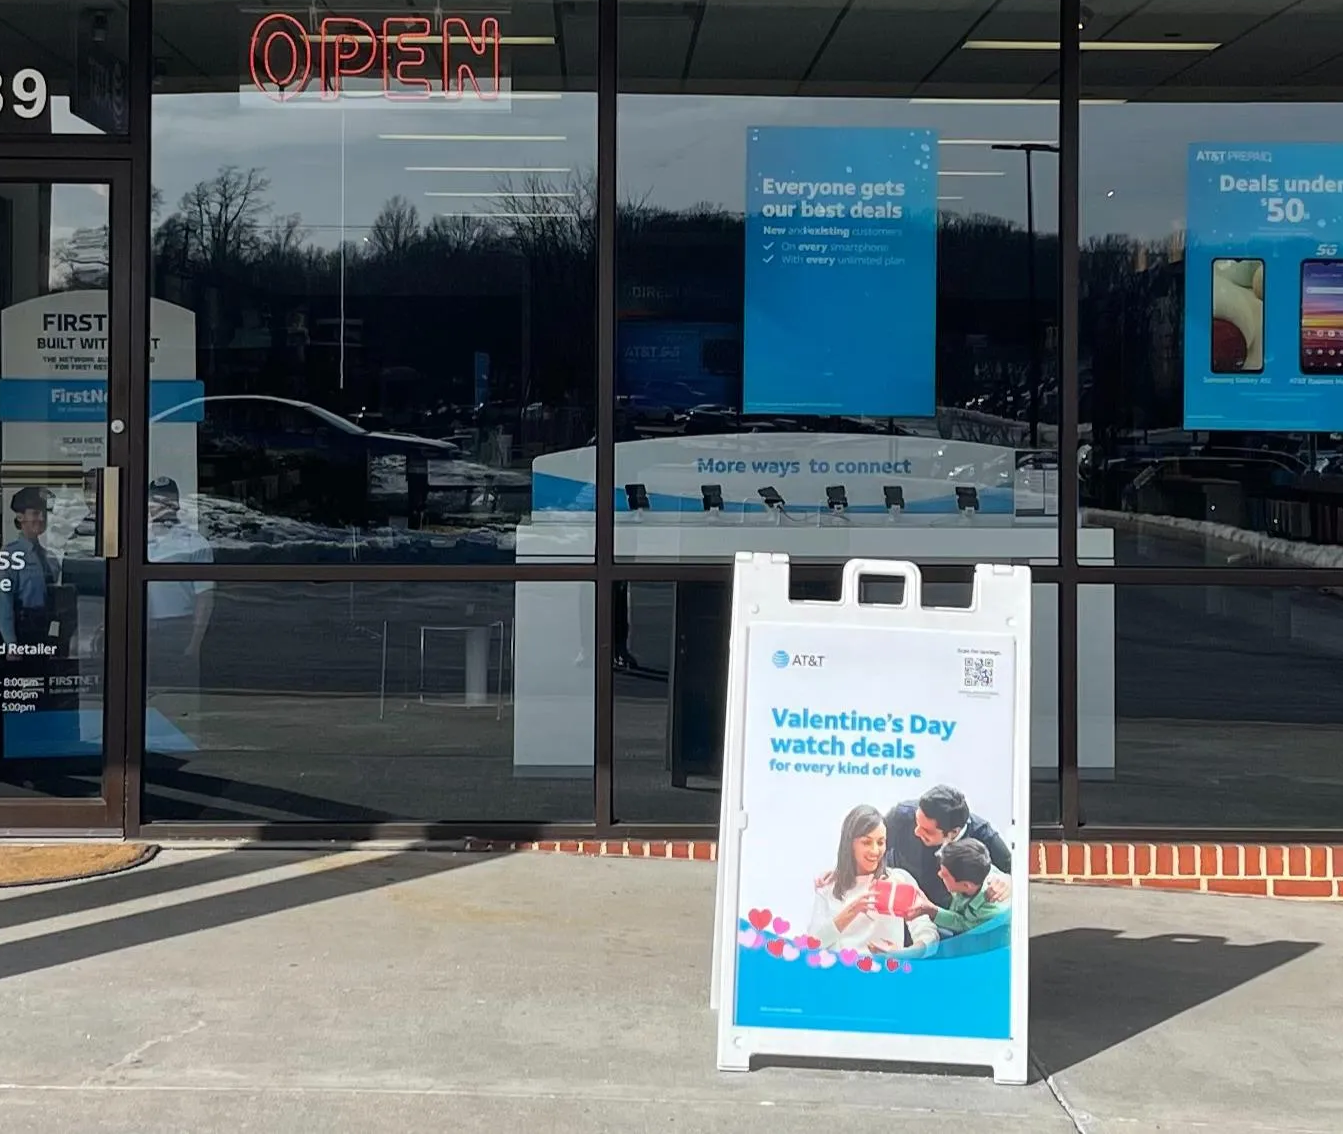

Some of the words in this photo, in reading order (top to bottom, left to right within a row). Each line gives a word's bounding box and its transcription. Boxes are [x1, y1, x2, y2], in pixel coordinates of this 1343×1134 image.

[249, 13, 500, 103] OPEN
[1196, 150, 1227, 162] AT&T
[762, 177, 856, 200] Everyone
[860, 179, 906, 200] gets
[1219, 174, 1279, 193] Deals
[762, 203, 797, 218] our
[801, 200, 846, 218] best
[850, 201, 903, 219] deals
[763, 226, 786, 235] New
[808, 226, 850, 238] existing
[798, 243, 828, 253] every
[1315, 244, 1339, 256] 5G
[806, 255, 836, 266] every
[37, 337, 76, 350] BUILT
[80, 337, 108, 350] WIT
[51, 388, 108, 404] FirstN
[697, 458, 747, 474] More
[752, 460, 801, 478] ways
[809, 458, 830, 474] to
[835, 459, 912, 474] connect
[8, 643, 57, 656] Retailer
[792, 654, 826, 667] AT&T
[49, 675, 99, 686] FIRSTNET
[771, 707, 905, 733] Valentine's
[910, 714, 957, 741] Day
[771, 735, 845, 756] watch
[851, 737, 915, 759] deals
[769, 758, 790, 772] for
[794, 763, 834, 776] every
[838, 761, 869, 775] kind
[873, 763, 889, 776] of
[891, 764, 921, 778] love
